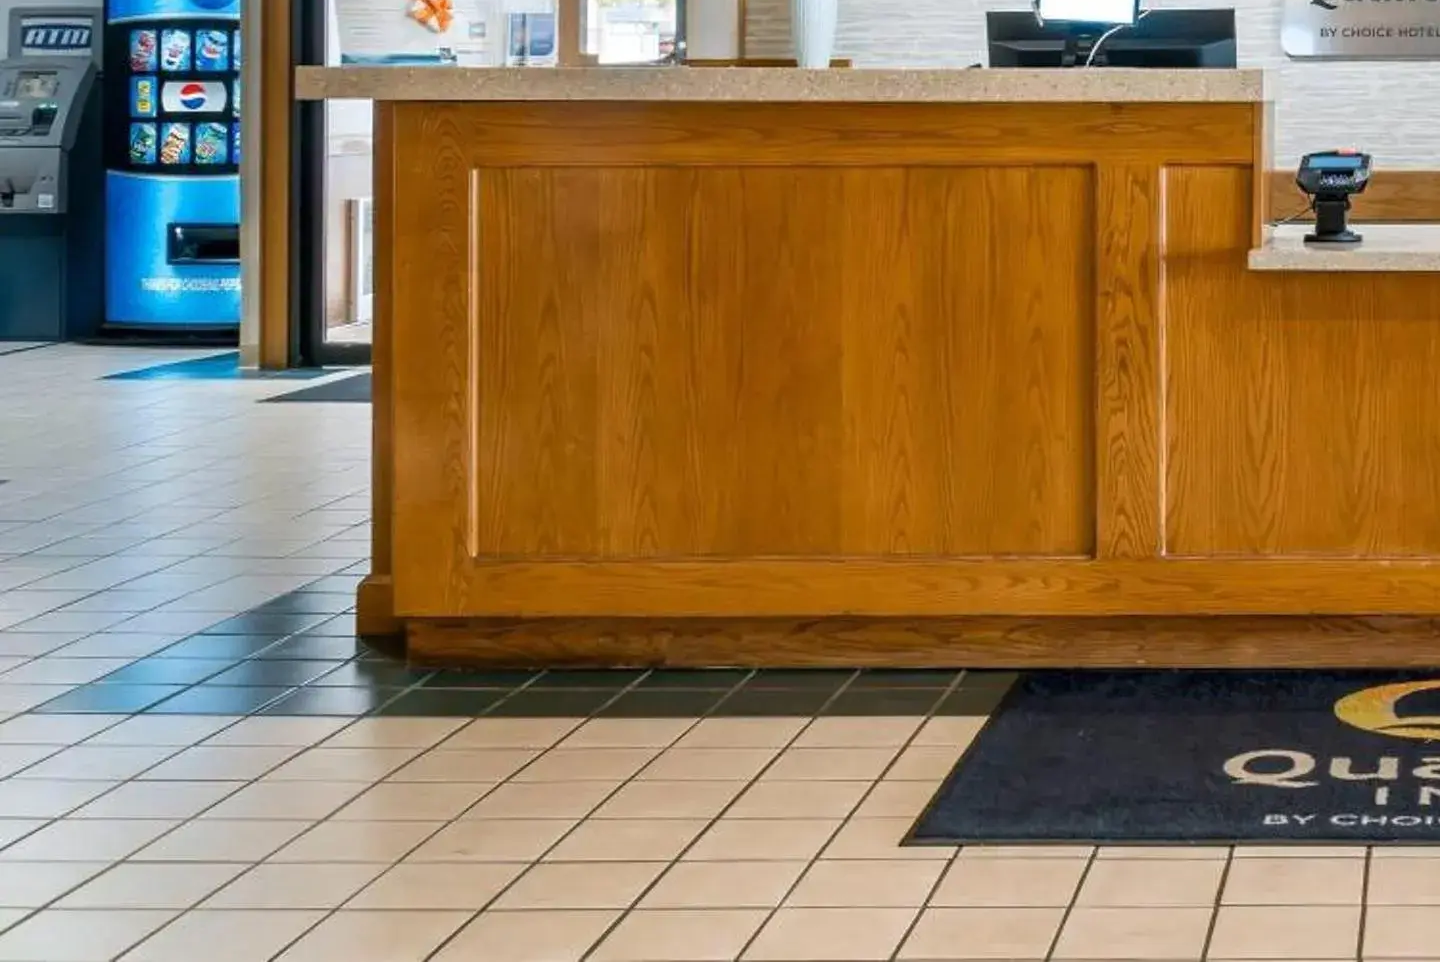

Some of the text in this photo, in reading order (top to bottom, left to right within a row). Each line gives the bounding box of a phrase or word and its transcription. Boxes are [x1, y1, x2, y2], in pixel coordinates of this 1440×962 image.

[25, 28, 90, 45] ATM
[1320, 27, 1337, 38] BY
[1342, 27, 1393, 38] CHOICE
[1263, 814, 1316, 826] BY
